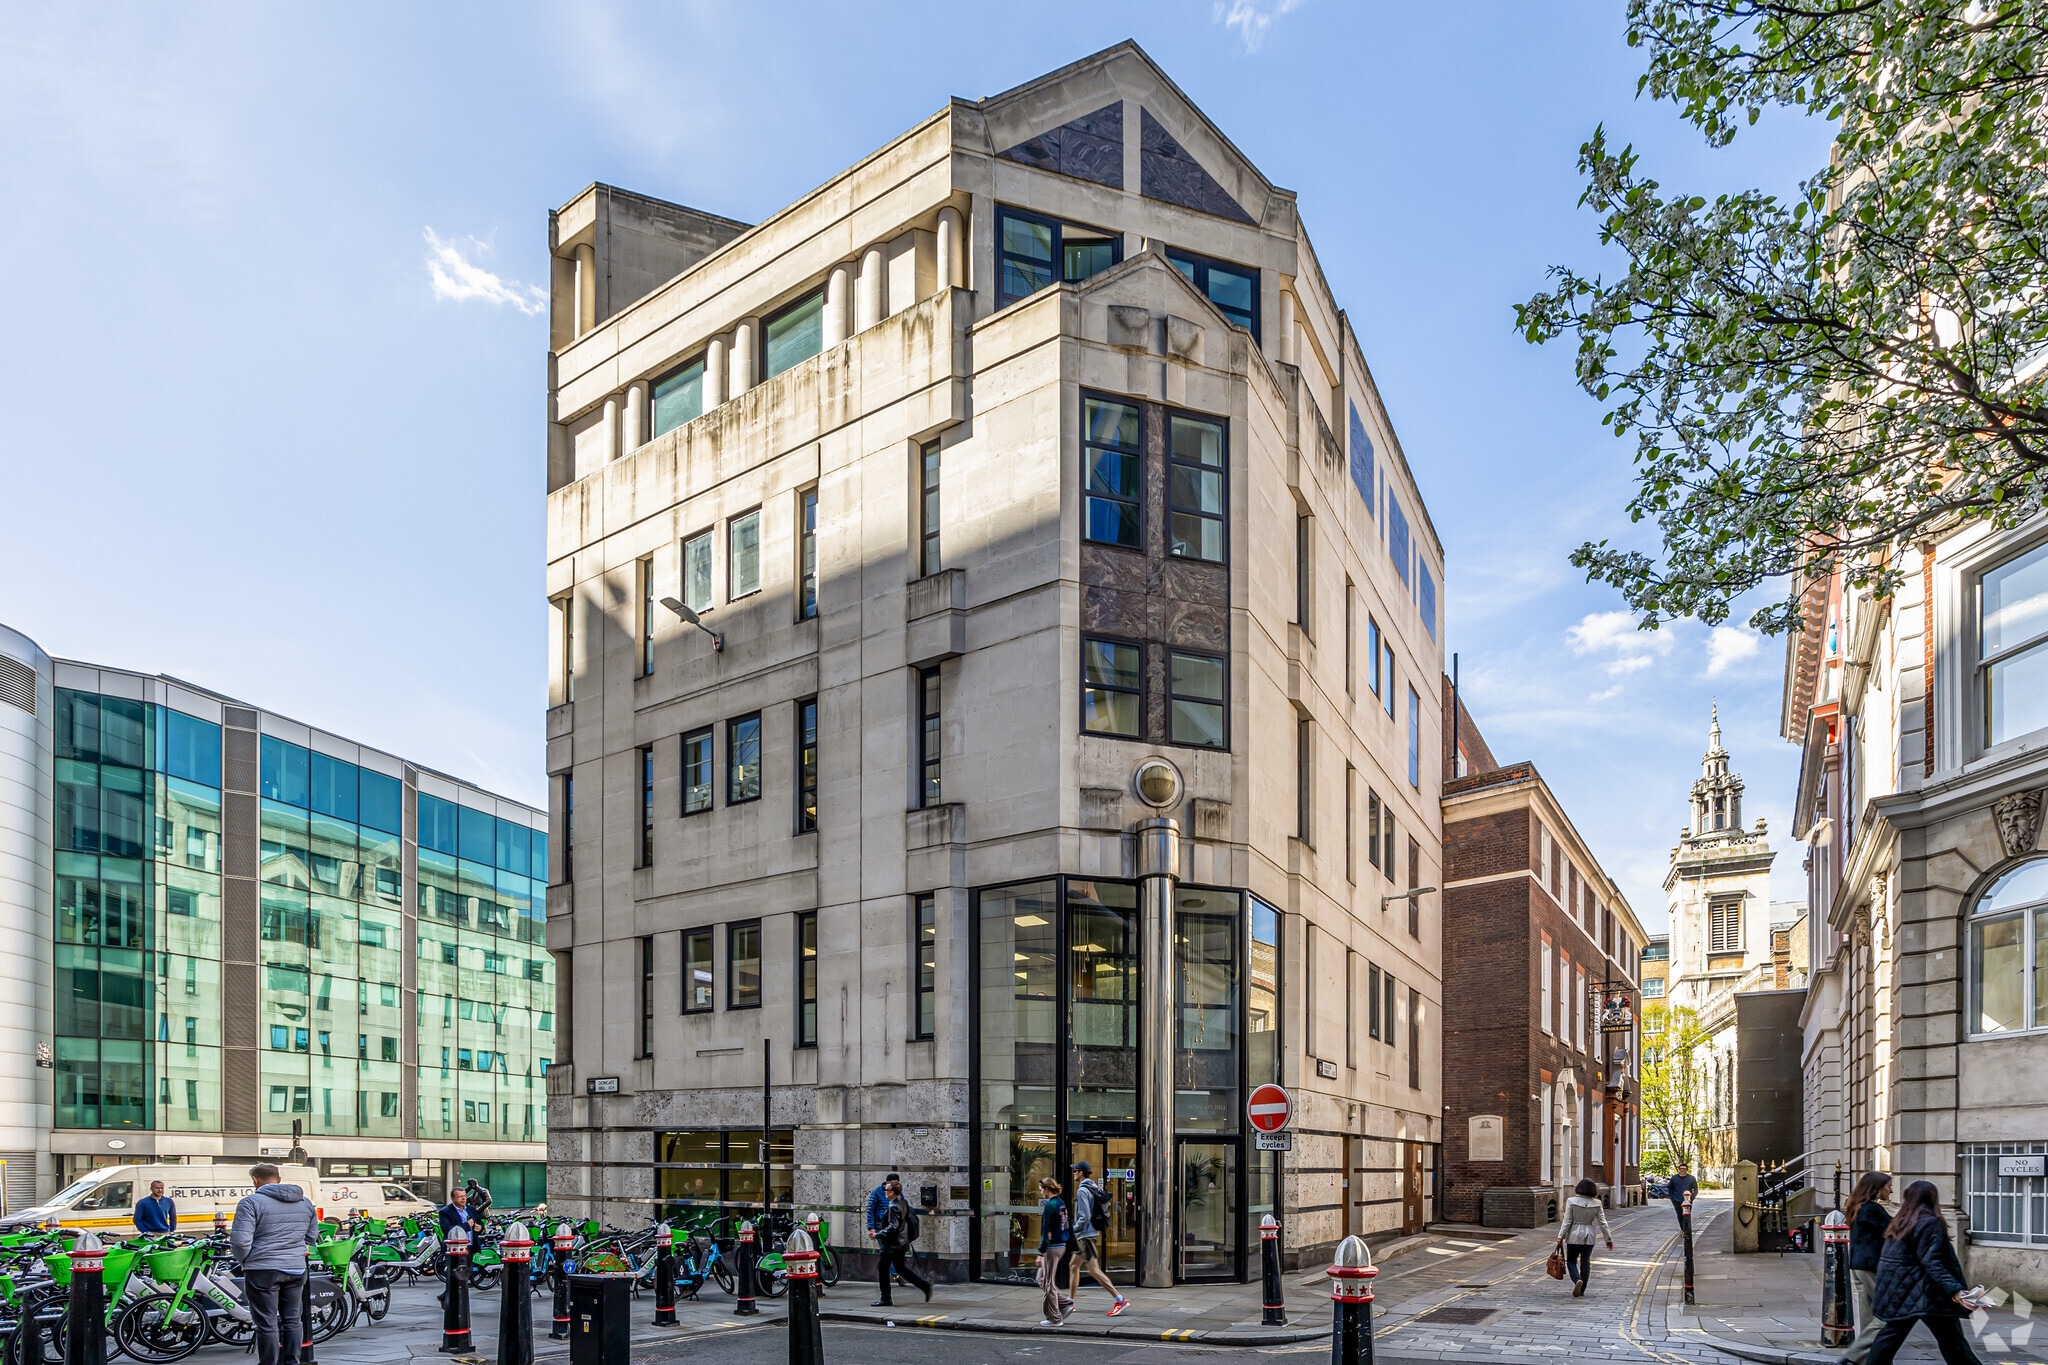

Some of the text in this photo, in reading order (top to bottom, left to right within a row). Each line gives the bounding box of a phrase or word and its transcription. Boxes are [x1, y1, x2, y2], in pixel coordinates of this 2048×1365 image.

[1260, 1133, 1286, 1141] Except
[169, 1189, 187, 1198] JRL
[190, 1188, 226, 1198] PLANT
[229, 1188, 237, 1197] &
[332, 1191, 358, 1200] TBG
[207, 1286, 236, 1310] Lime
